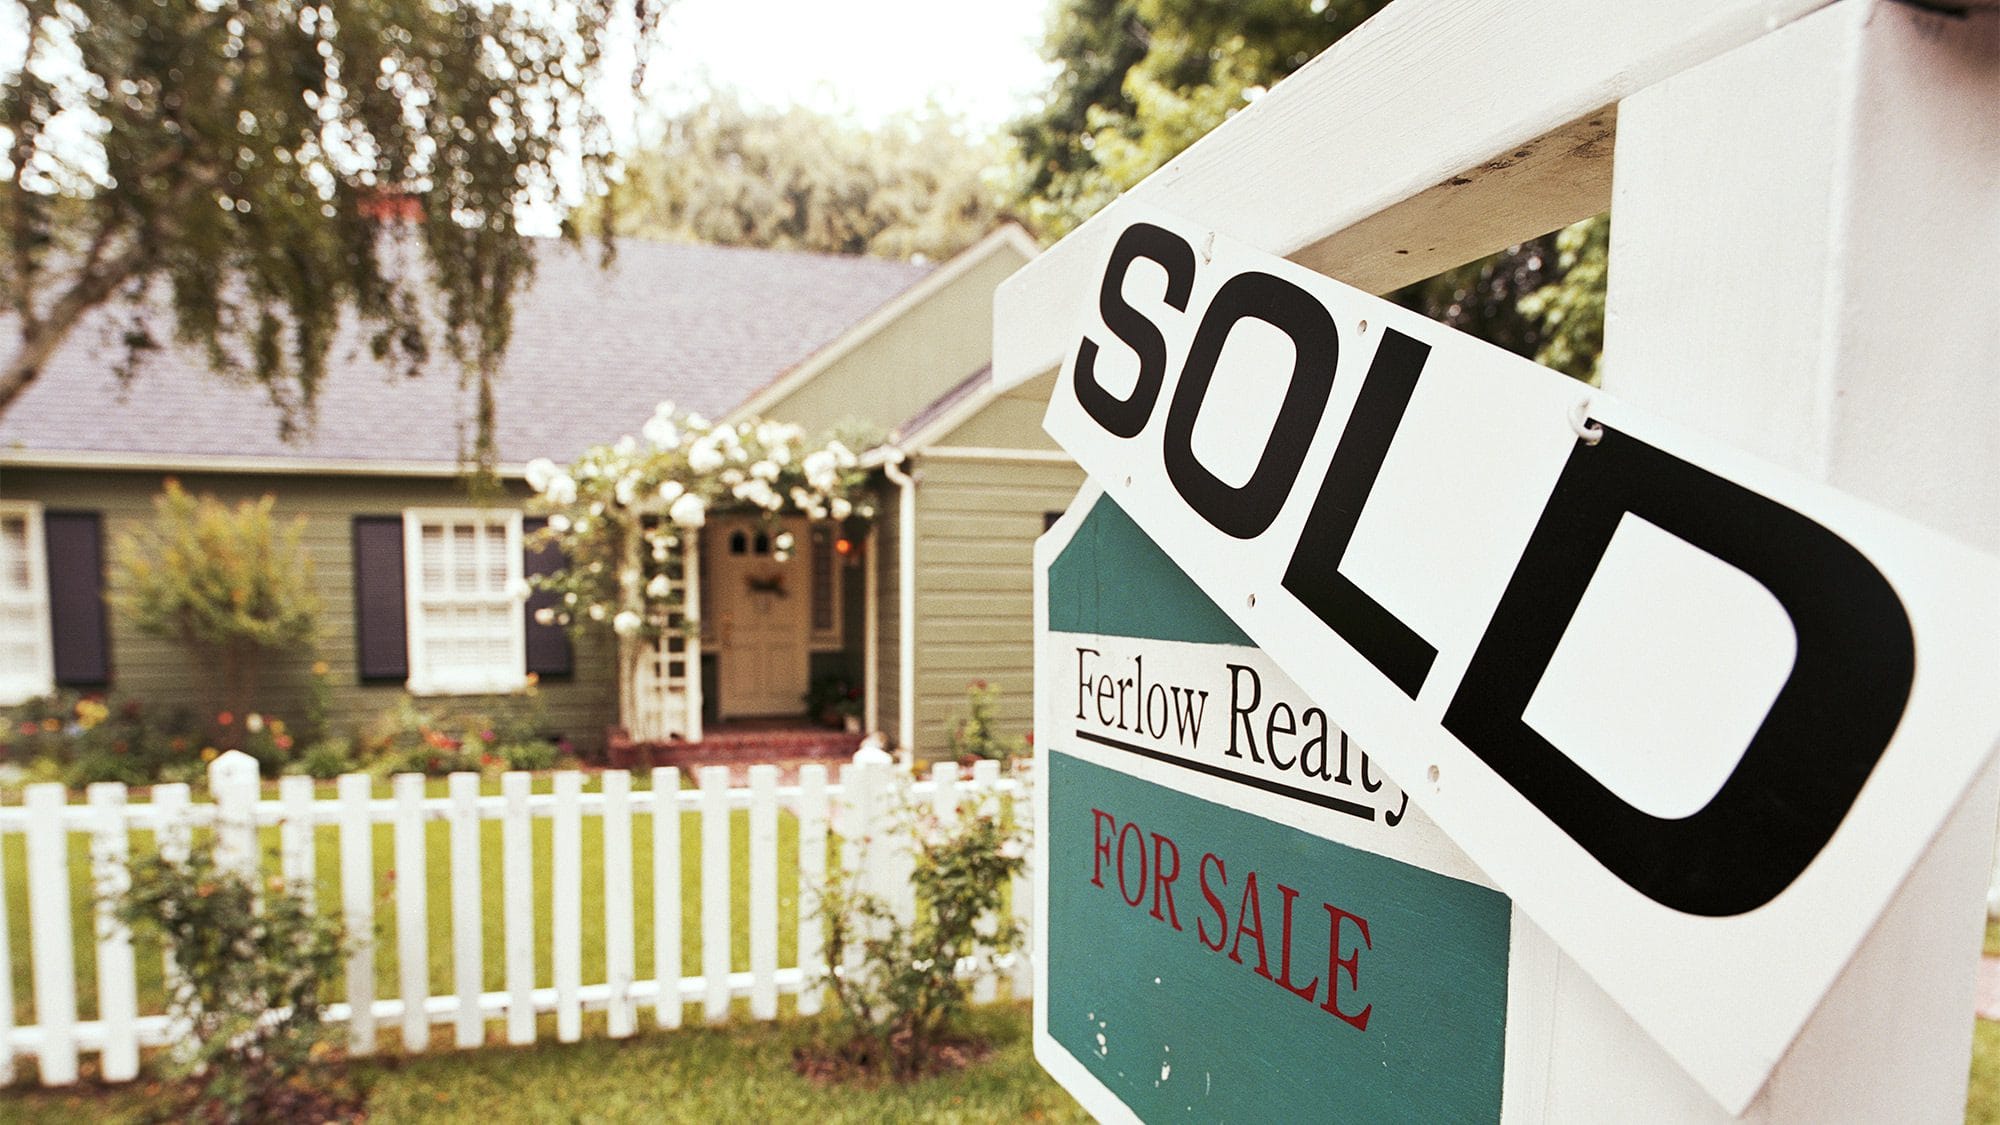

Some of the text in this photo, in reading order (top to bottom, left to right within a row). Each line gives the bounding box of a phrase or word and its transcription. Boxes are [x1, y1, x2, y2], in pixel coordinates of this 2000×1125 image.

[1073, 222, 1915, 918] SOLD
[1076, 647, 1209, 749] Ferlow
[1090, 808, 1373, 1032] FOR SALE
